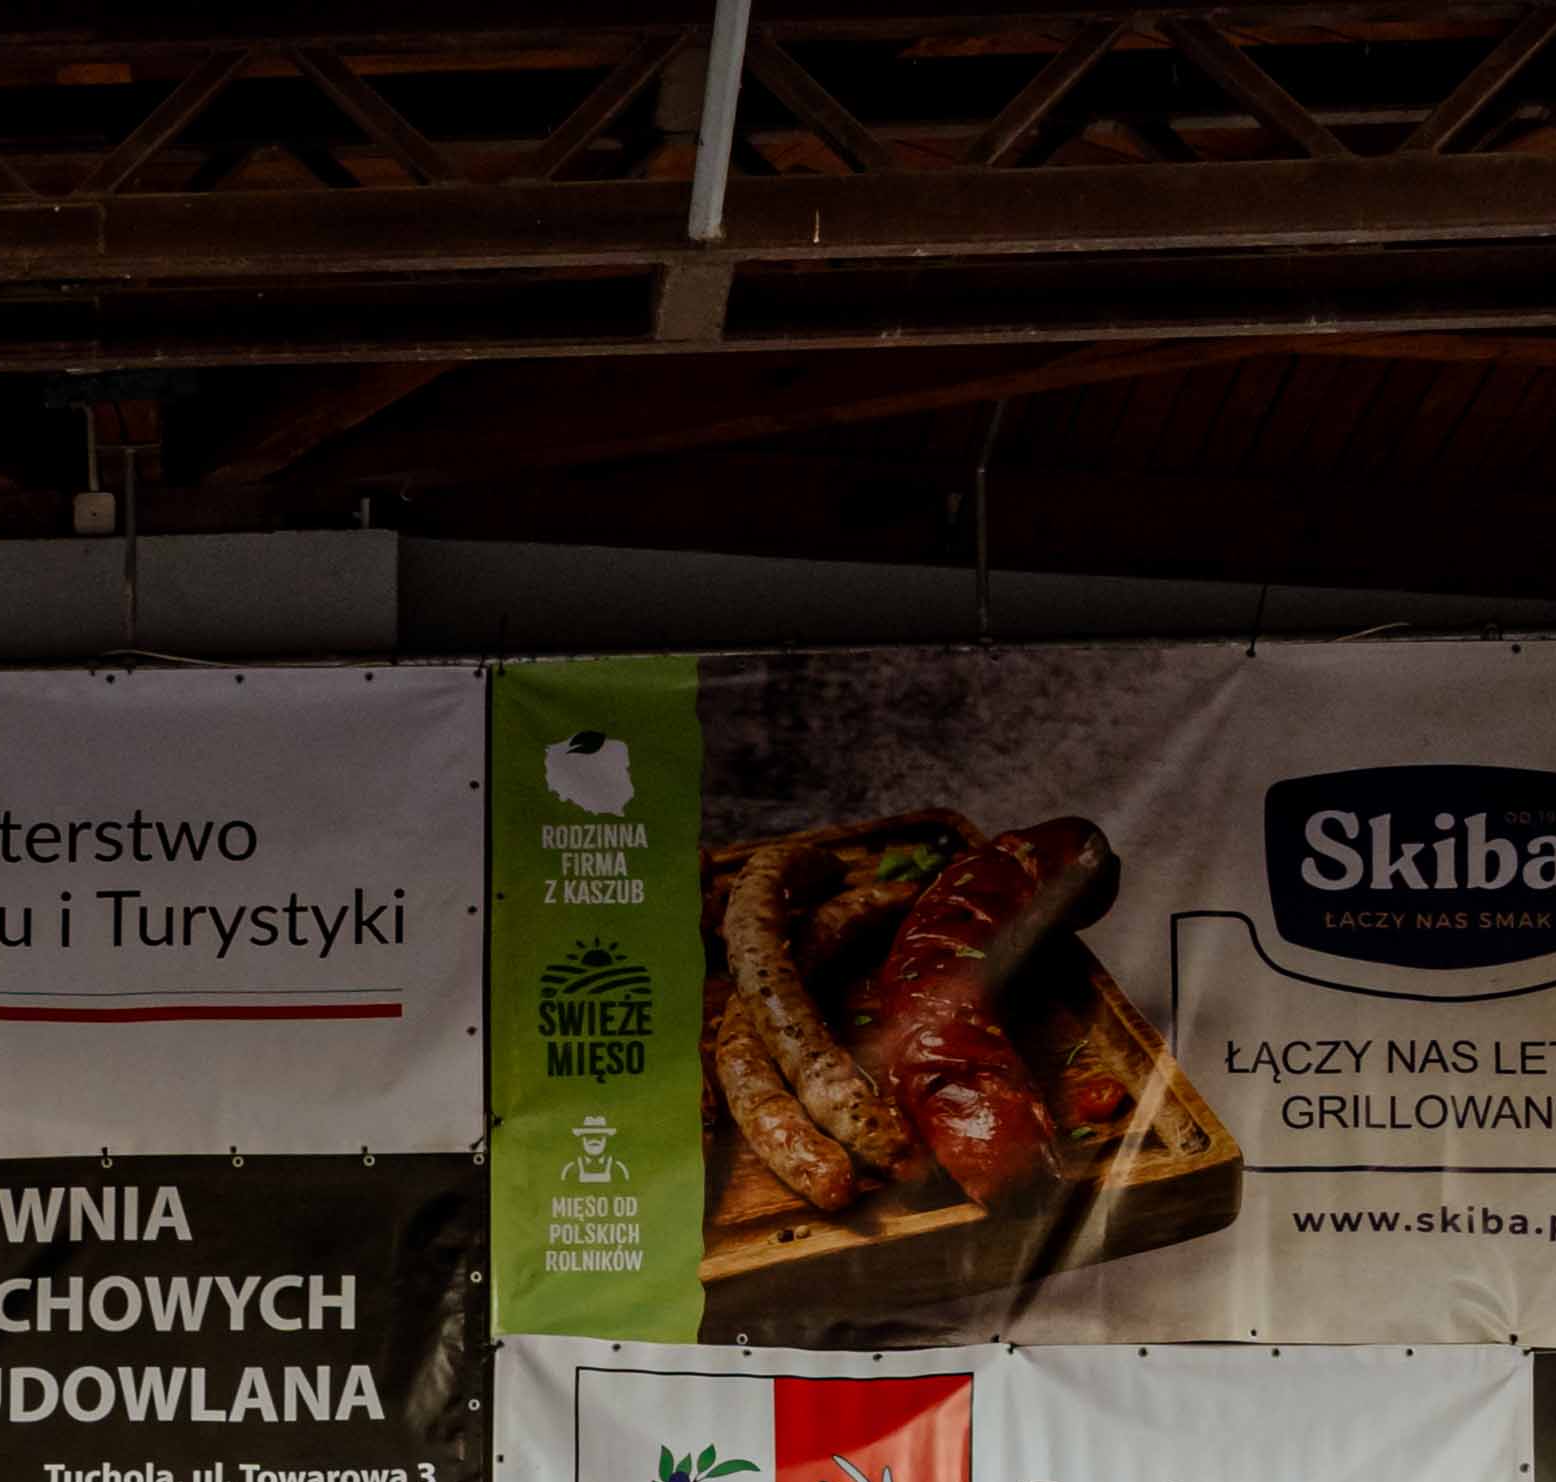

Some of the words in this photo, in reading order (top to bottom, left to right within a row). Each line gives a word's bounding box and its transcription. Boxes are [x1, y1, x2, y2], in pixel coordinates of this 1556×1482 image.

[542, 823, 649, 849] RODZINNA
[561, 851, 628, 877] FIRMA
[543, 880, 557, 905] Z
[563, 879, 646, 905] KASZUB
[58, 890, 73, 949] i
[96, 886, 408, 960] Turystyki
[1324, 911, 1406, 932] ŁĄCZY
[1415, 911, 1469, 930] NAS
[1478, 911, 1553, 930] SMAK
[547, 1040, 646, 1083] MIĘSO
[1224, 1040, 1373, 1084] ŁĄCZY
[1387, 1040, 1480, 1074] NAS
[551, 1195, 609, 1222] MIĘSO
[613, 1196, 638, 1217] OD
[549, 1223, 640, 1245] POLSKICH
[545, 1245, 644, 1272] ROLNIKÓW
